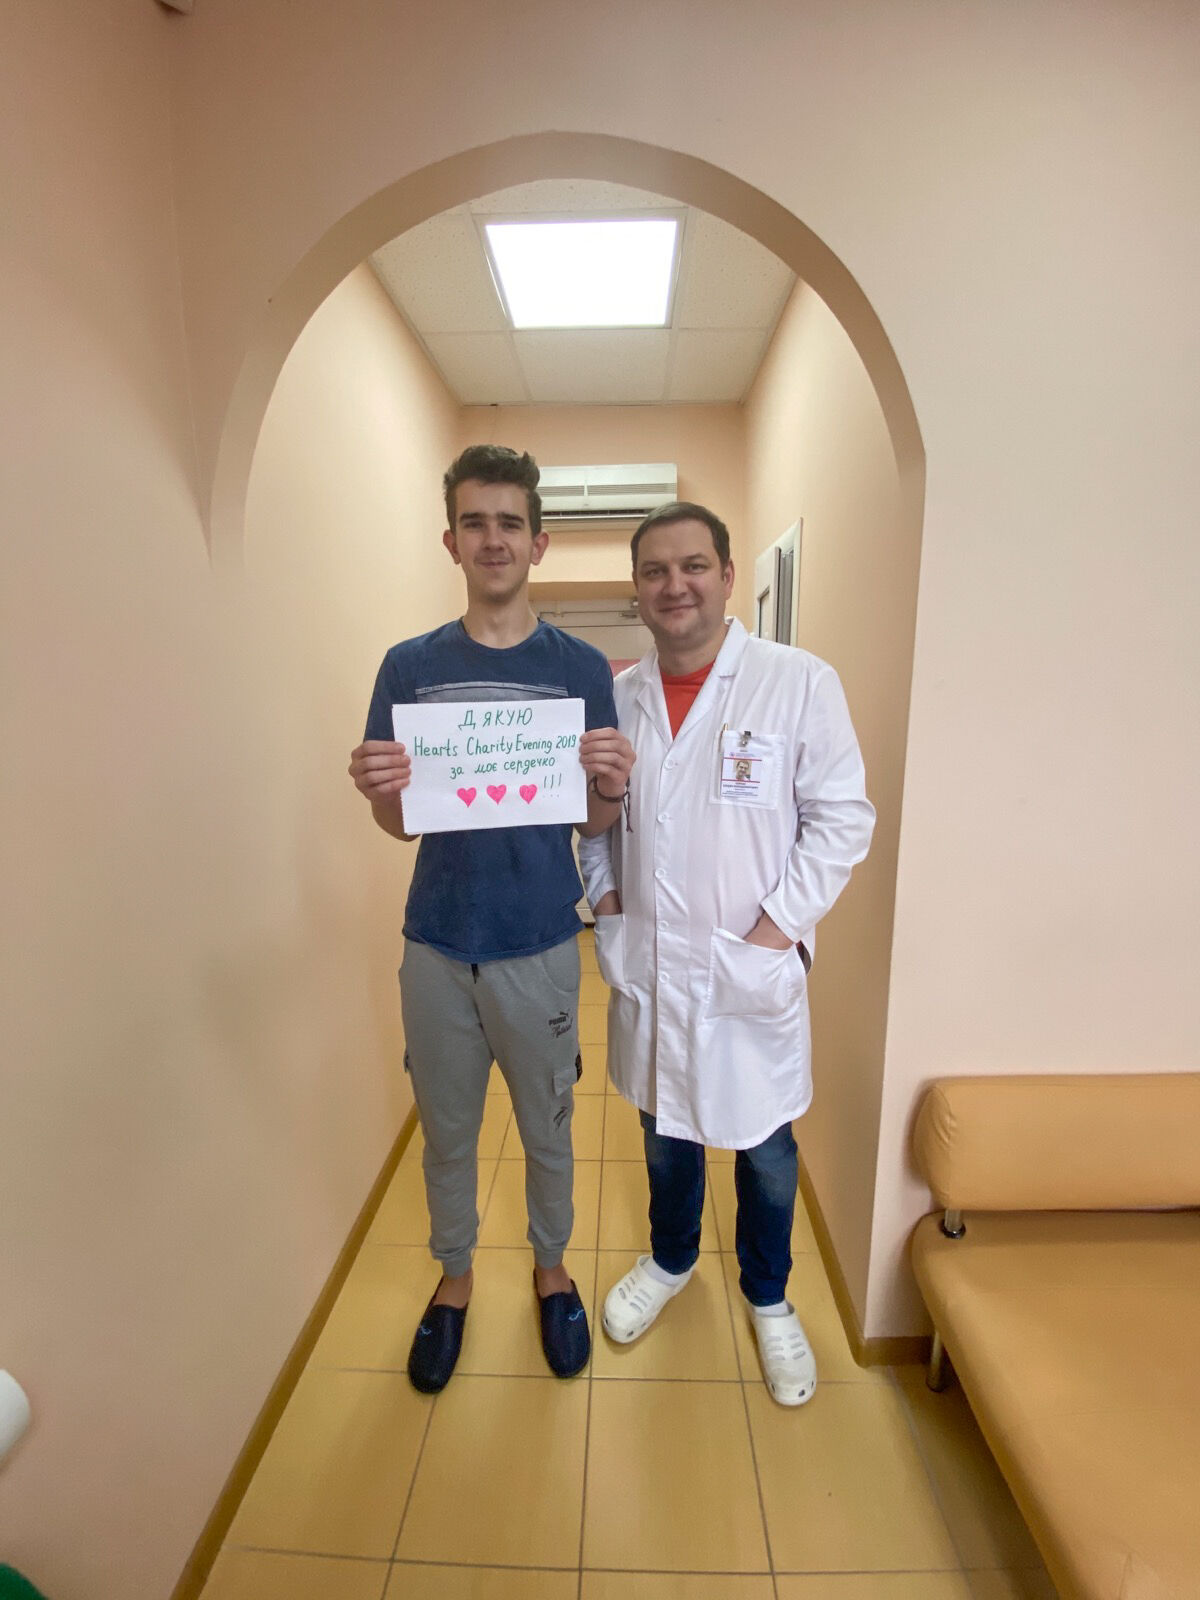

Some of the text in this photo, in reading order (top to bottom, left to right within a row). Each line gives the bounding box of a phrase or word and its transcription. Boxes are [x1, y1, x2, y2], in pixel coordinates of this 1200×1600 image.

[458, 708, 533, 731] ДЯКУЮ
[414, 733, 577, 756] Hearts Charity Evening 2019
[449, 757, 556, 780] за моє сердечко
